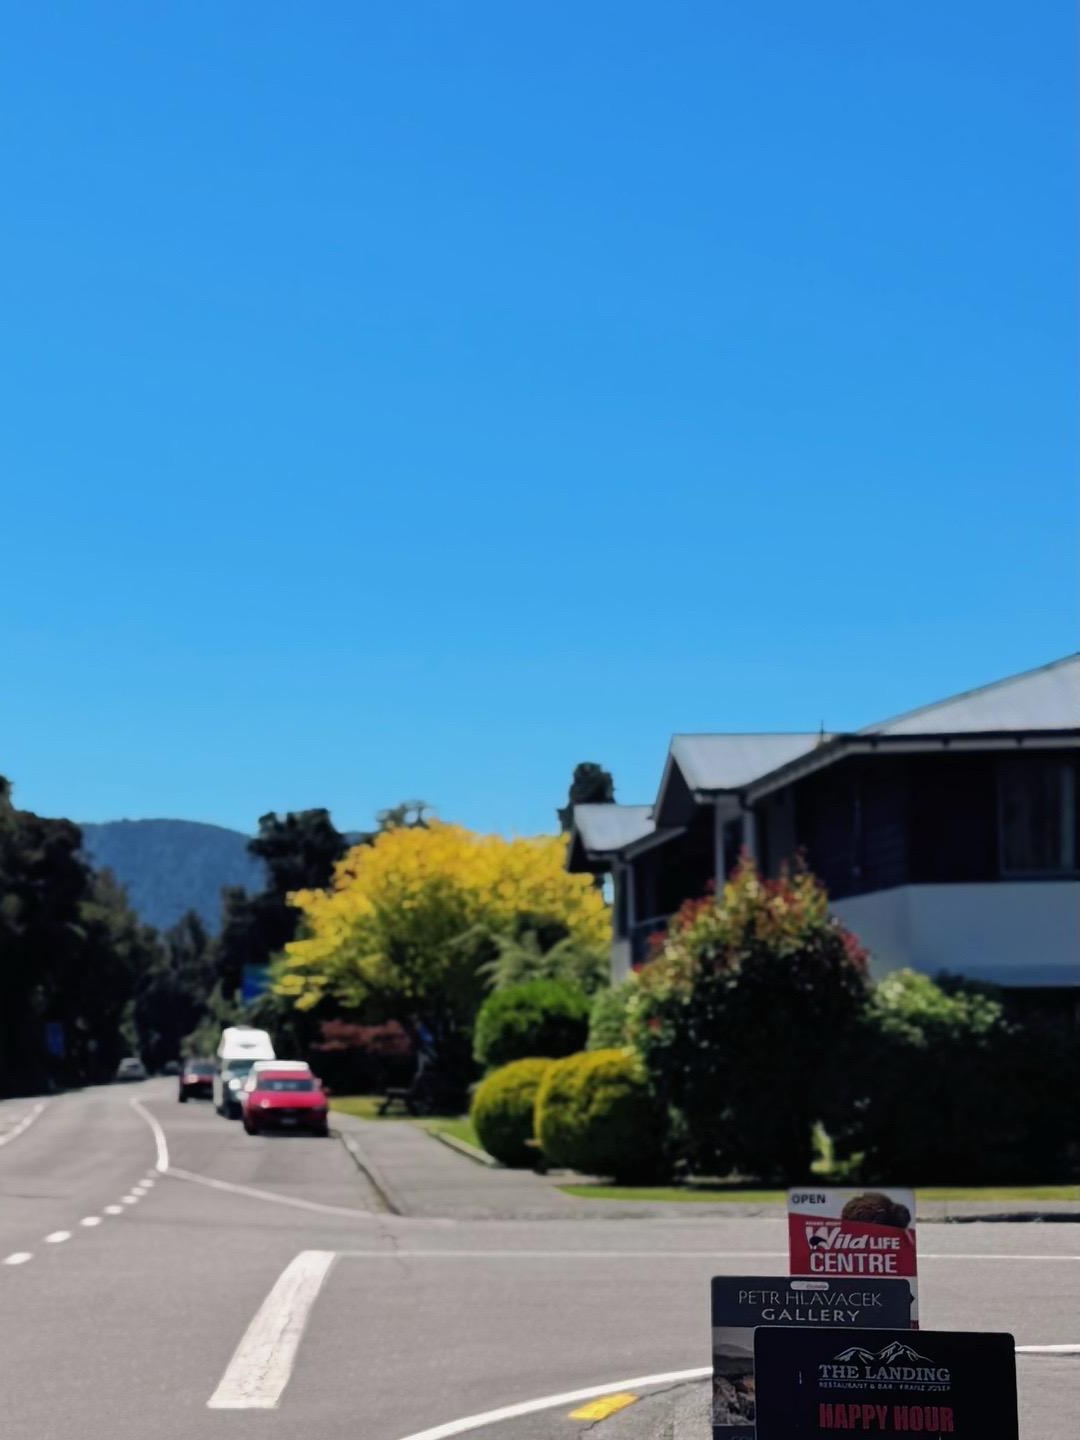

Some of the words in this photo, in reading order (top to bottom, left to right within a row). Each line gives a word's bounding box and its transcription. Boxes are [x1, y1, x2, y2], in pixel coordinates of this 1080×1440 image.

[792, 1194, 826, 1204] OPEN
[805, 1226, 868, 1250] Wild
[869, 1237, 900, 1249] LIFE
[810, 1253, 897, 1273] CENTRE
[738, 1290, 780, 1305] PETR
[785, 1290, 883, 1307] HLAVACEK
[761, 1308, 860, 1323] GALLERY
[818, 1364, 859, 1379] THE
[866, 1366, 951, 1381] LANDING
[818, 1403, 888, 1430] HAPPY
[893, 1405, 954, 1432] HOUR
